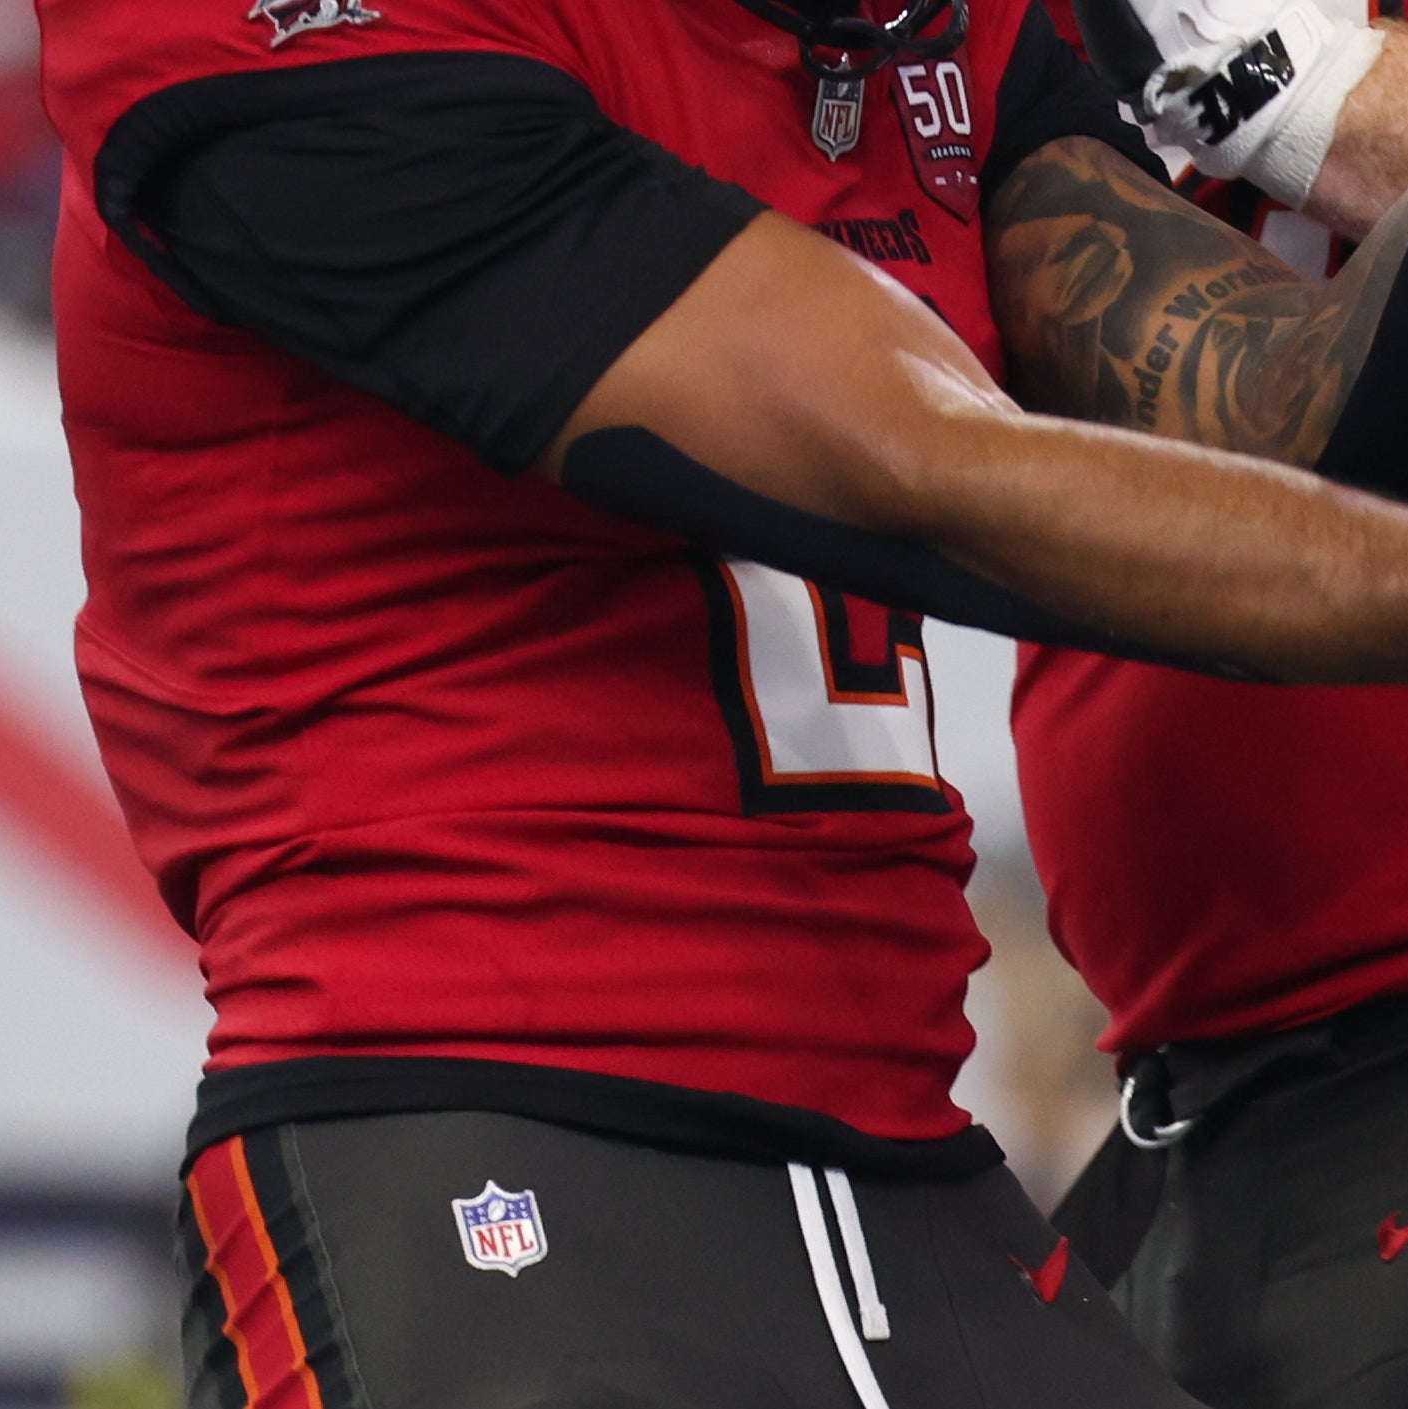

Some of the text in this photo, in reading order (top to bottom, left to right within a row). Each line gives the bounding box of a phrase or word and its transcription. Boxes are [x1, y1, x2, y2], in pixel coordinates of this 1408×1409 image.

[822, 101, 856, 141] NFL
[897, 61, 972, 138] 50
[1133, 323, 1180, 427] nder
[475, 1222, 535, 1258] NFL
